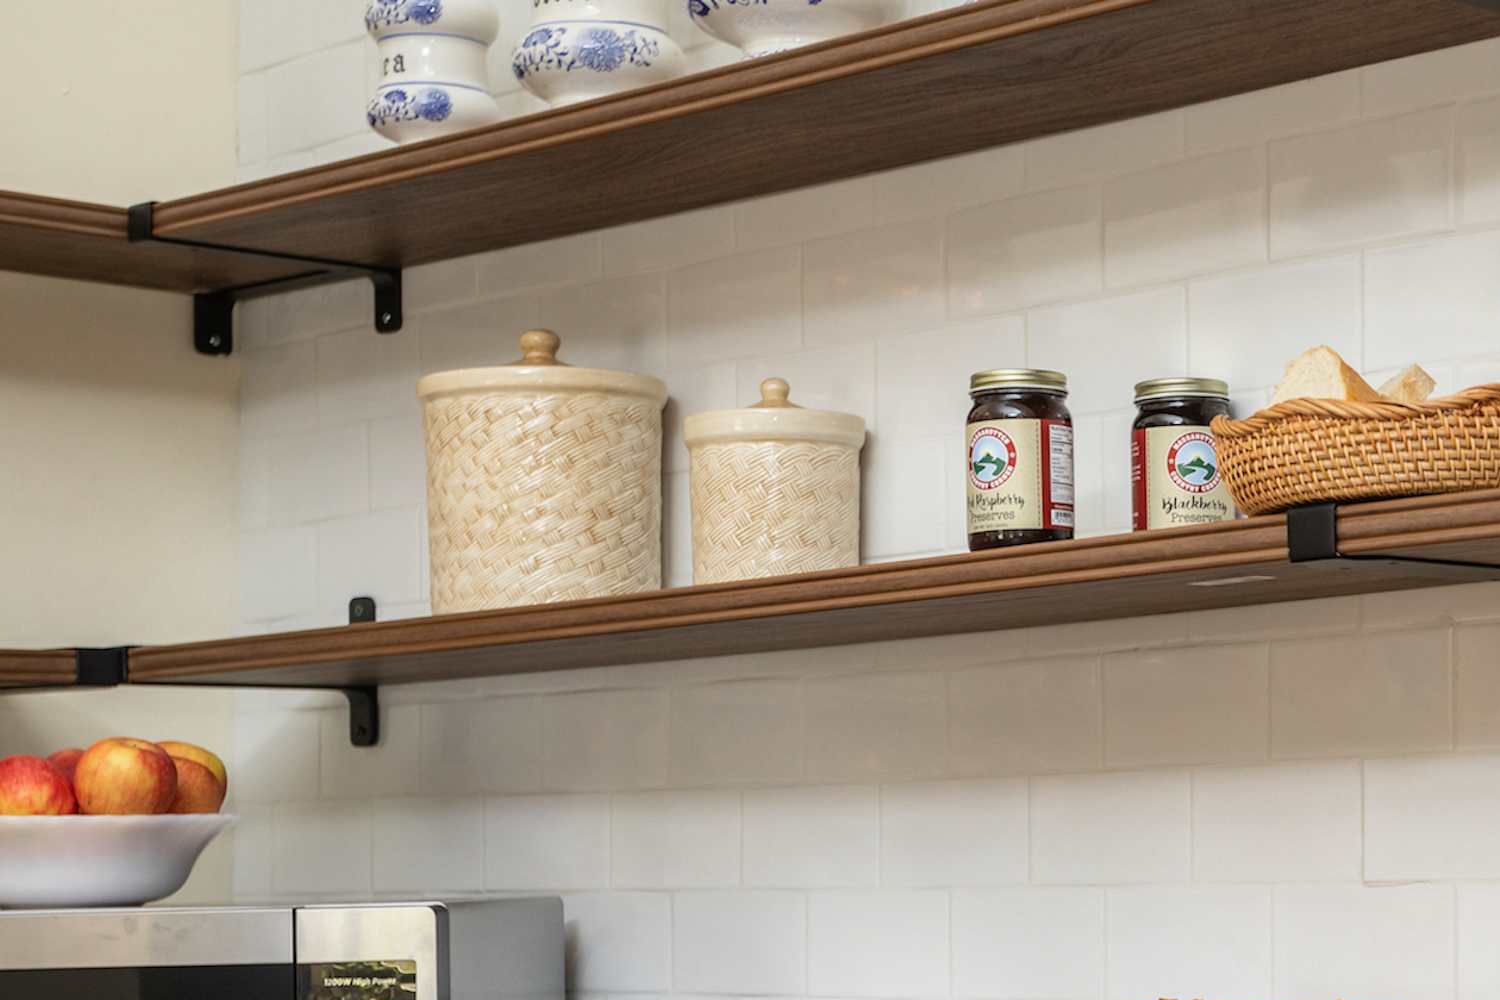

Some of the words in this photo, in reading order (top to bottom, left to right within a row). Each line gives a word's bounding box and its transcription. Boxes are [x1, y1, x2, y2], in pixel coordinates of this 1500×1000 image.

[1162, 496, 1228, 513] Blackberry
[324, 977, 352, 987] 1200W
[352, 977, 371, 988] High
